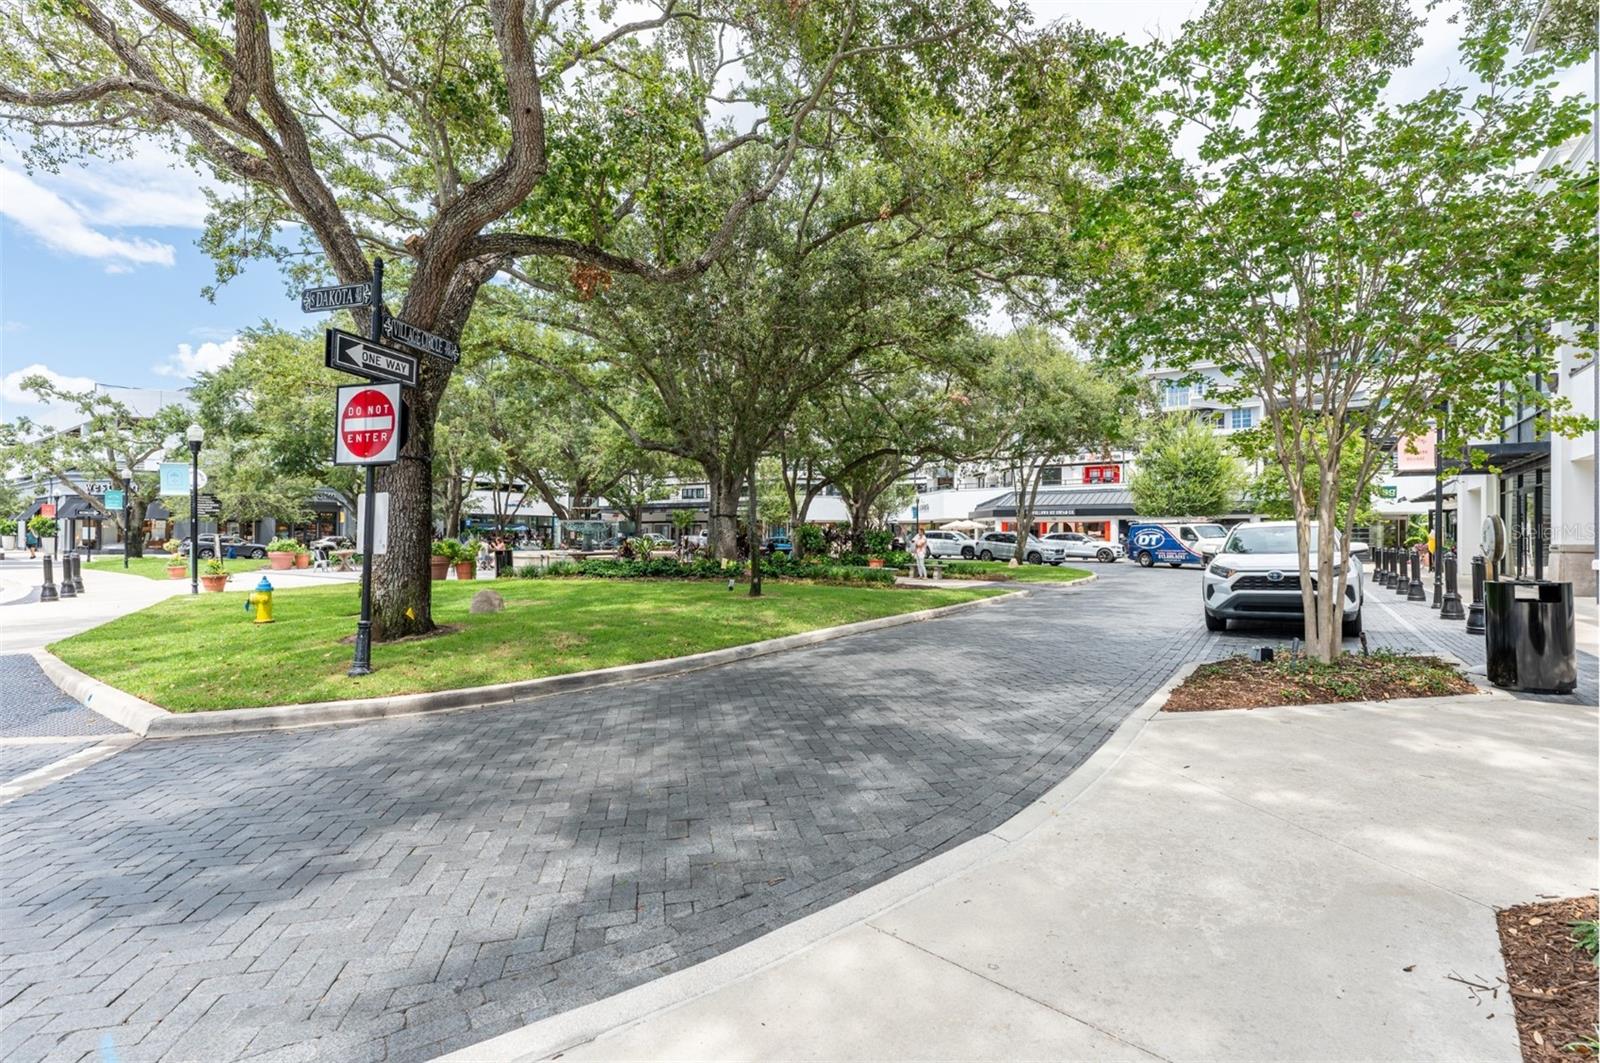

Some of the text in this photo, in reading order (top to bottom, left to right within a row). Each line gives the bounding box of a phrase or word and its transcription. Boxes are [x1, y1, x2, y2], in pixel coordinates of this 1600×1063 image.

[310, 294, 316, 306] S
[316, 288, 354, 306] DAKOTA
[393, 321, 422, 346] VILLAGE
[362, 352, 408, 376] ONE WAY
[348, 404, 390, 416] DO NOT
[347, 432, 388, 443] ENTER
[1139, 534, 1160, 546] DT
